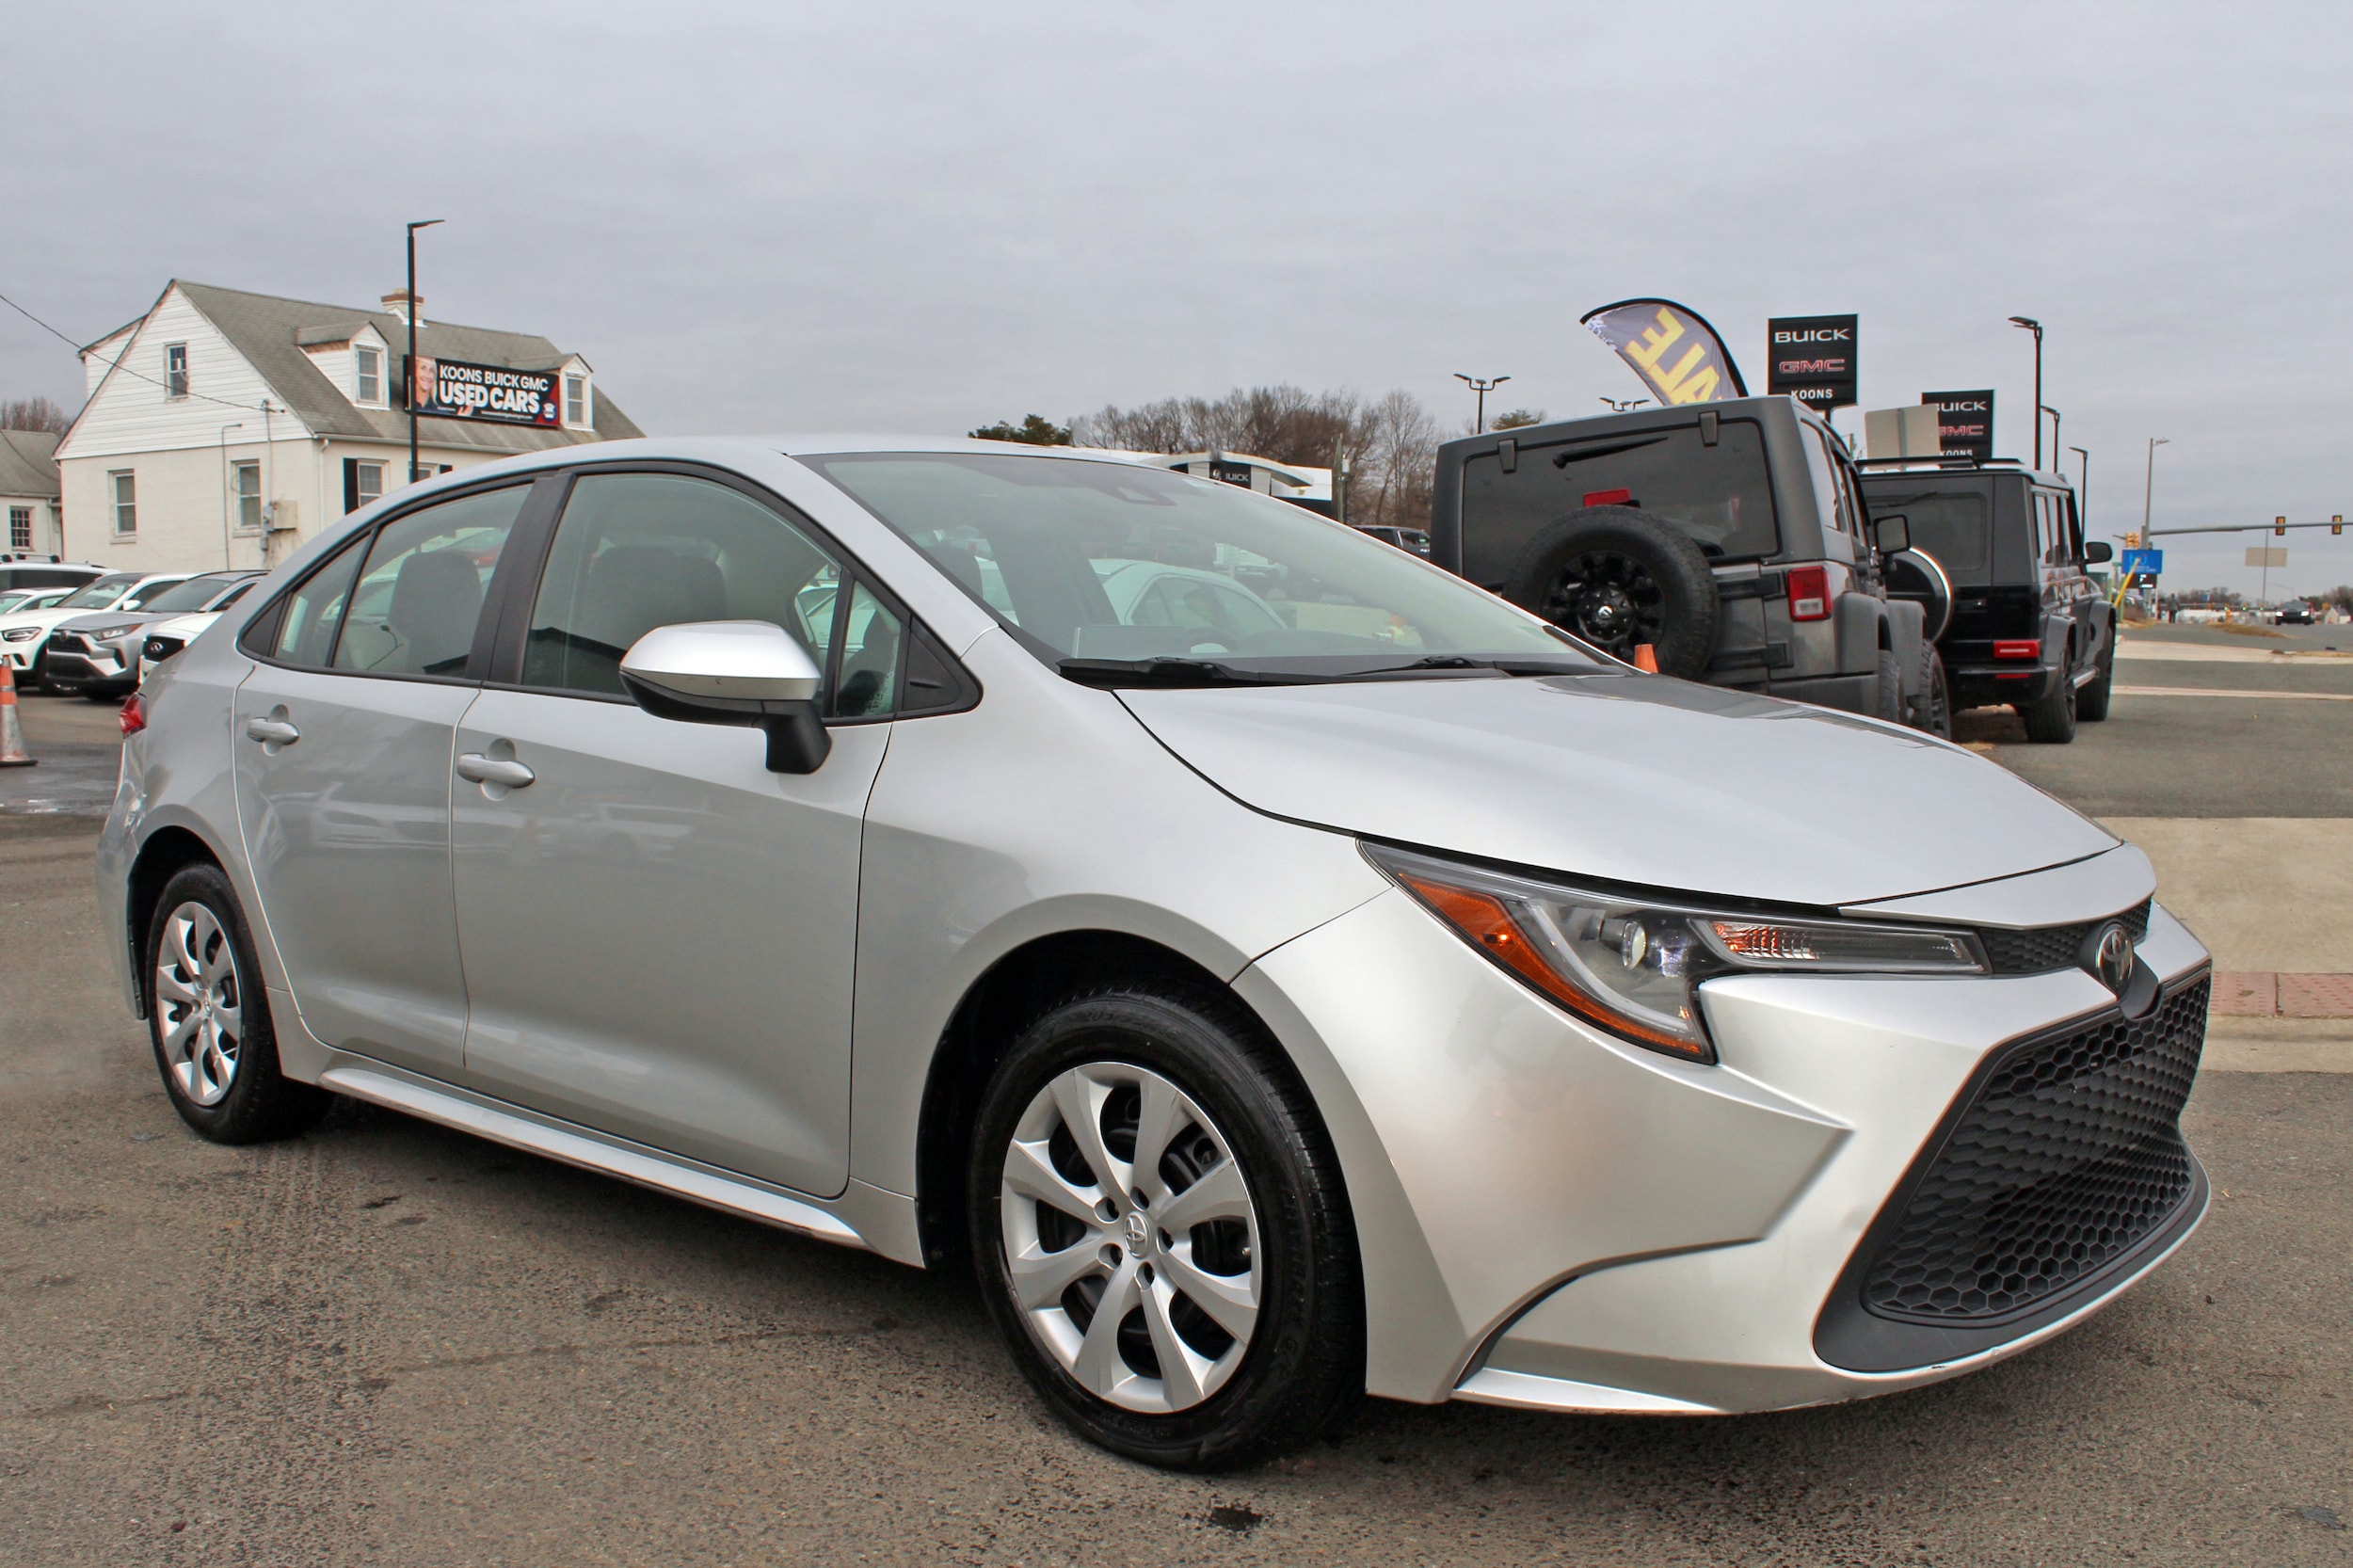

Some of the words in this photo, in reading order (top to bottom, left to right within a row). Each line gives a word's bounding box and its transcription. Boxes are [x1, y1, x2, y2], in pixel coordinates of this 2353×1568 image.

[1774, 328, 1850, 344] BUICK
[1779, 359, 1845, 374] GMC
[440, 365, 483, 384] KOONS
[485, 371, 520, 388] BUICK
[520, 376, 549, 392] GMC
[440, 381, 489, 408] USED
[489, 388, 540, 414] CARS
[1790, 388, 1833, 400] KOONS
[1936, 401, 1987, 412] UICK
